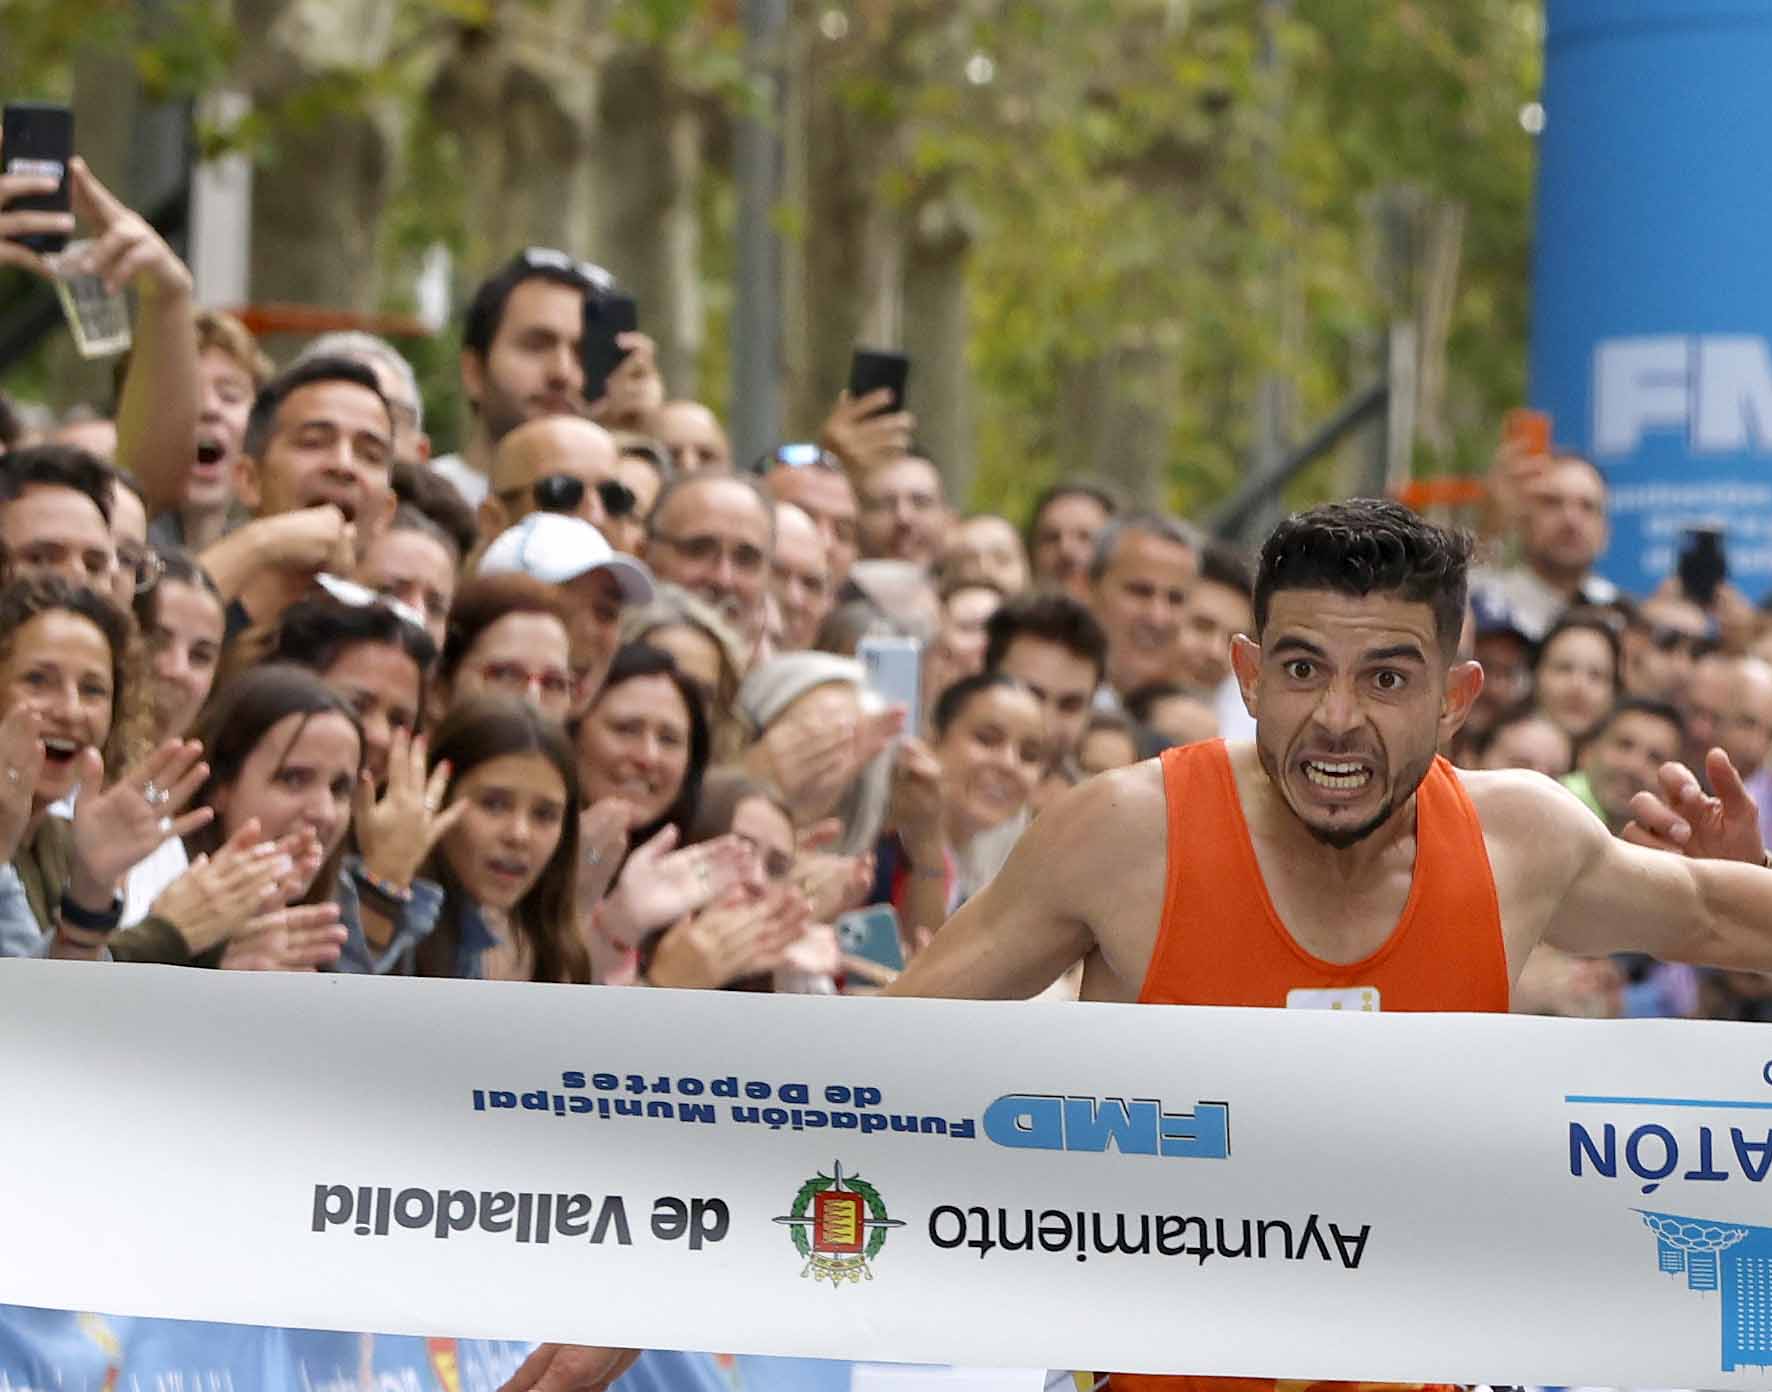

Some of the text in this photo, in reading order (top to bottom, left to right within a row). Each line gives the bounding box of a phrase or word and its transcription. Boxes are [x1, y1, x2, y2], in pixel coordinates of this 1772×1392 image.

[472, 1089, 976, 1140] Fundación Municipal
[562, 1071, 882, 1109] de Deportes
[983, 1093, 1232, 1160] FMD
[312, 1184, 1372, 1270] Ayuntamiento de Valladolid
